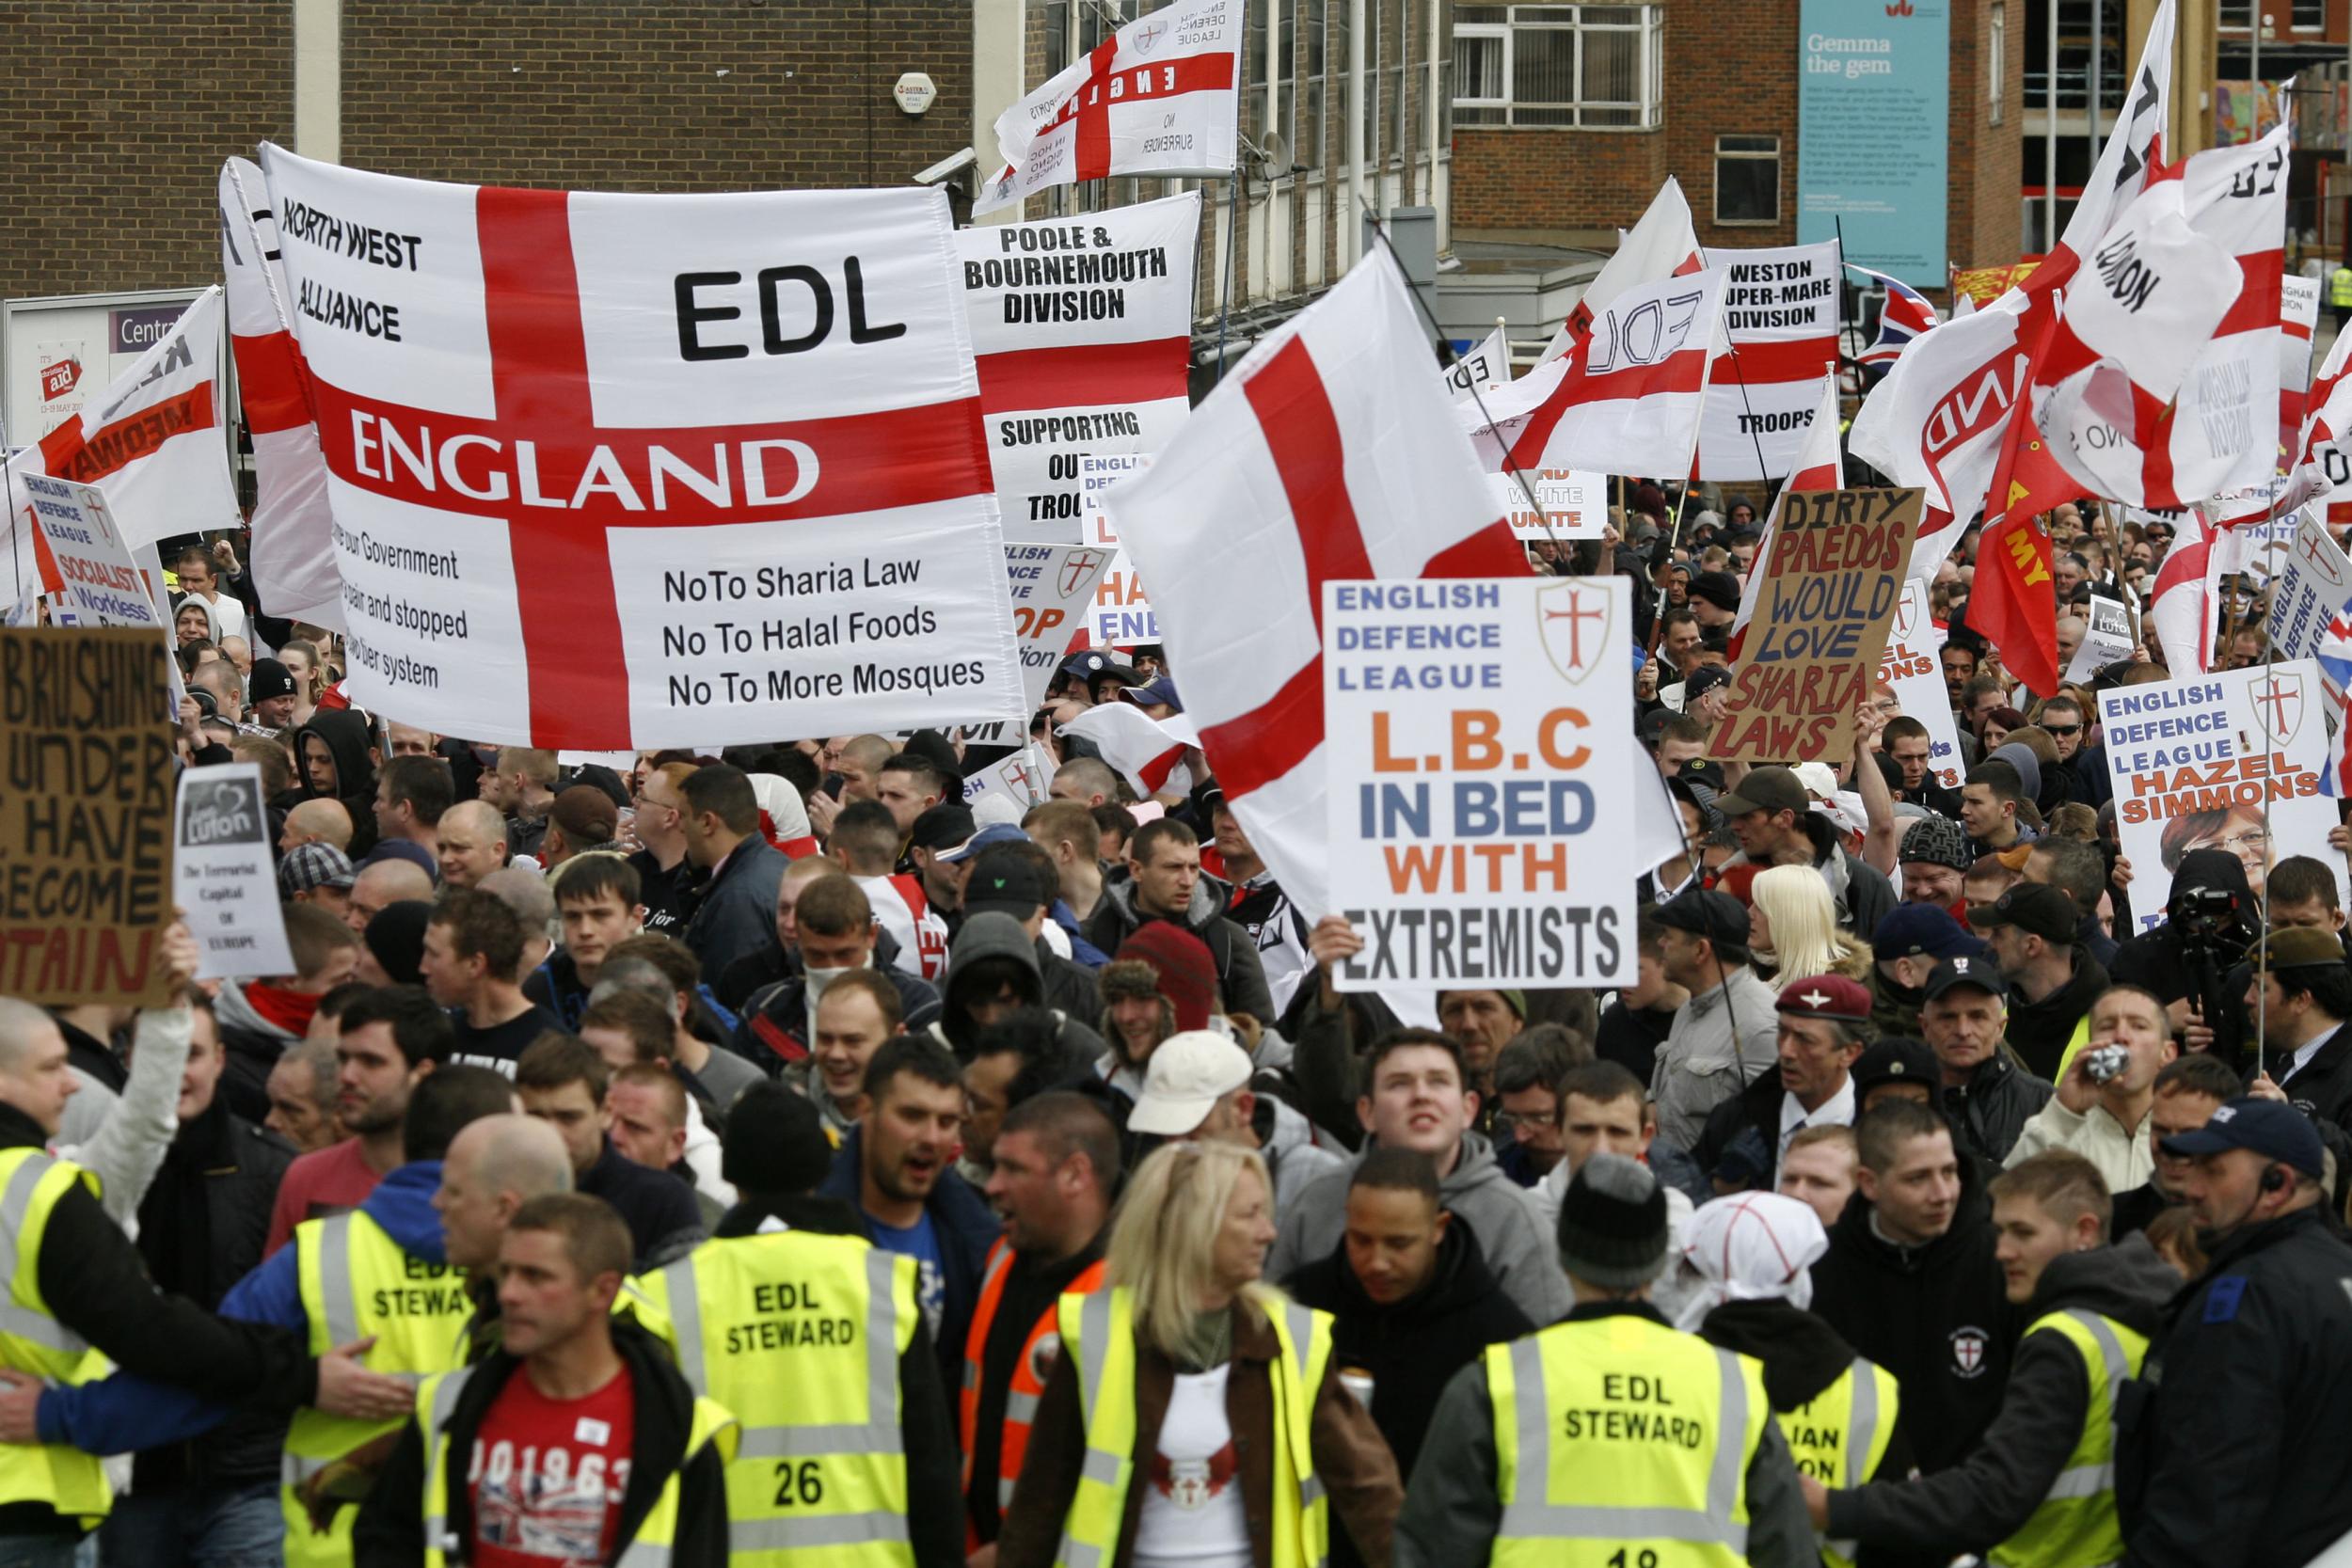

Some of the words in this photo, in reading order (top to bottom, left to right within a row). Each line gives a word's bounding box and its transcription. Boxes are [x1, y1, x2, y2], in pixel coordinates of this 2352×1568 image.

[1807, 34, 1891, 53] Gemma
[1806, 55, 1840, 73] the
[1845, 57, 1891, 79] gem
[282, 197, 342, 254] NORTH
[346, 221, 421, 272] WEST
[1000, 226, 1085, 253] POOLE
[1093, 226, 1113, 247] &
[964, 246, 1167, 291] BOURNEMOUTH
[1730, 260, 1811, 282] WESTON
[297, 277, 402, 341] ALLIANCE
[675, 255, 906, 361] EDL
[1004, 288, 1124, 325] DIVISION
[1725, 278, 1832, 306] UPER-MARE
[1729, 306, 1816, 329] DIVISION
[50, 363, 73, 392] aid
[1000, 411, 1140, 448] SUPPORTING
[1738, 409, 1816, 434] TROOPS
[351, 409, 820, 513] ENGLAND
[1049, 452, 1091, 481] OU
[24, 477, 72, 499] ENGLISH
[1509, 487, 1583, 504] WHITE
[34, 499, 83, 522] DEFENCE
[1512, 512, 1582, 528] UNITE
[1783, 491, 1915, 531] DIRTY
[44, 522, 93, 545] LEAGUE
[58, 553, 140, 594] SOCIALIST
[361, 531, 459, 579] Government
[755, 563, 853, 597] Sharia
[864, 557, 921, 588] Law
[73, 586, 151, 622] Workless
[1336, 584, 1501, 610] ENGLISH
[1772, 571, 1895, 624] WOULD
[2268, 562, 2300, 639] ENGLISH
[368, 594, 391, 624] and
[395, 599, 468, 642] stopped
[663, 626, 706, 657] No
[714, 622, 752, 654] To
[762, 615, 838, 649] Halal
[849, 606, 936, 641] Foods
[2305, 604, 2335, 660] EAGUE
[1337, 625, 1502, 651] DEFENCE
[1754, 623, 1866, 663] LOVE
[4, 636, 167, 731] BRUSHING
[383, 654, 438, 689] system
[669, 675, 712, 706] No
[721, 672, 757, 703] To
[768, 669, 843, 701] More
[853, 659, 985, 696] Mosques
[1338, 665, 1502, 691] LEAGUE
[1727, 662, 1867, 715] SHARIA
[2106, 683, 2224, 719] ENGLISH
[1372, 707, 1592, 773] L.B.C
[1708, 714, 1836, 762] LAWS
[2110, 711, 2229, 746] DEFENCE
[2115, 738, 2233, 774] LEAGUE
[2132, 752, 2302, 798] HAZEL
[1360, 781, 1429, 839] IN
[1454, 780, 1596, 837] BED
[2122, 770, 2321, 824] SIMMONS
[24, 796, 163, 871] HAVE
[1382, 843, 1567, 895] WITH
[1343, 906, 1621, 981] EXTREMISTS
[374, 1290, 464, 1317] STEWA
[755, 1282, 819, 1313] EDL
[725, 1318, 855, 1354] STEWARD
[1603, 1374, 1674, 1406] EDL
[1565, 1409, 1703, 1449] STEWARD
[773, 1461, 823, 1508] 26
